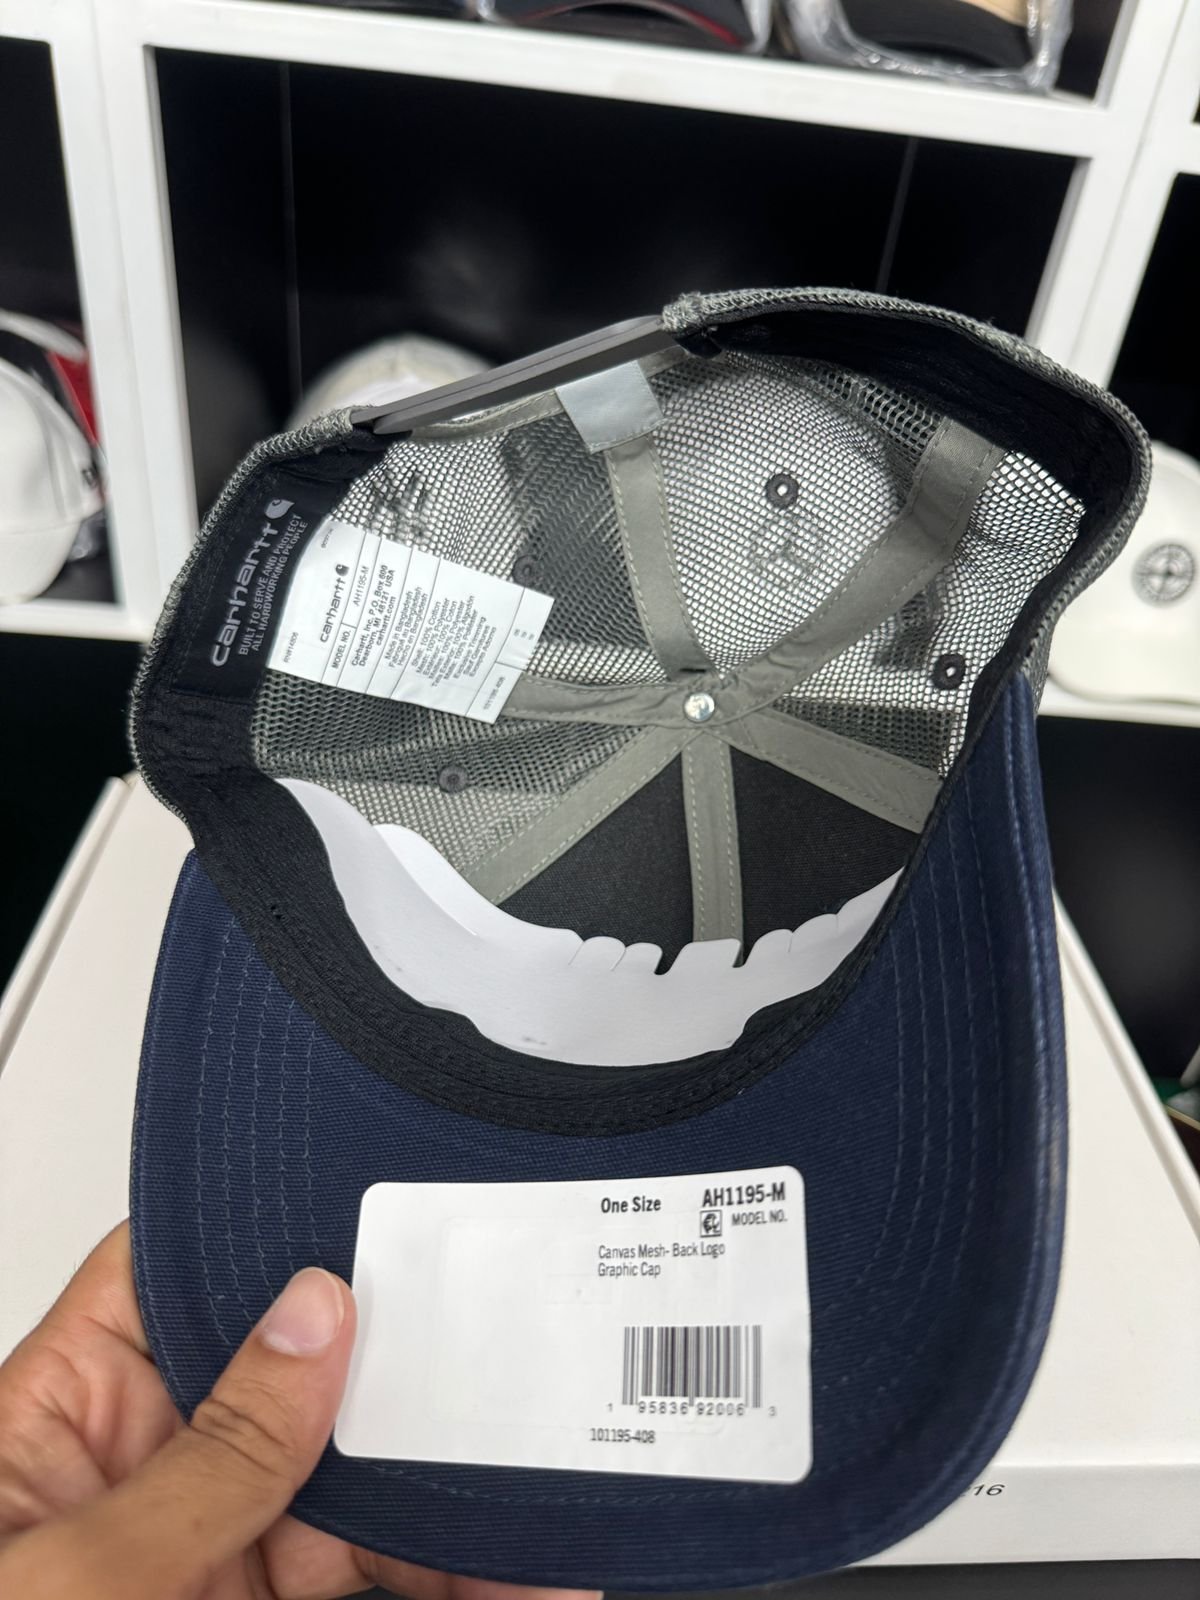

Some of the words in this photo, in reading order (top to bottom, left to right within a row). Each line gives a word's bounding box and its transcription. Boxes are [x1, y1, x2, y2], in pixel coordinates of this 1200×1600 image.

[273, 514, 302, 555] PROTECT
[262, 555, 278, 577] AND
[211, 521, 279, 668] carhartt
[251, 631, 264, 652] ALL
[258, 555, 288, 631] HARDWORKING
[282, 521, 308, 555] PEOPLE
[253, 577, 268, 610] SERVE
[353, 565, 369, 607] AH1195-M
[250, 610, 261, 625] TO
[319, 577, 345, 644] carhartt
[351, 631, 369, 667] Carhartt,
[368, 597, 380, 616] P.O.
[374, 580, 384, 597] Box
[379, 564, 388, 580] 600
[359, 628, 379, 667] Dearborn,
[377, 590, 390, 615] 48121
[385, 568, 395, 588] USA
[375, 596, 397, 646] carhartt.com
[404, 585, 424, 628] Bangladesh
[420, 626, 432, 646] 100%
[428, 600, 442, 626] Cotton
[385, 639, 397, 660] Made
[395, 590, 415, 633] Bangladesh
[397, 643, 411, 667] Hecho
[410, 592, 429, 635] Bangladesh
[426, 632, 439, 652] 100%
[433, 598, 451, 633] Polyester
[438, 623, 450, 643] 100%
[452, 625, 465, 646] 100%
[239, 627, 256, 657] BUILT
[332, 643, 346, 669] MODEL
[341, 629, 351, 643] NO.
[441, 635, 453, 655] 100%
[454, 641, 467, 660] 100%
[601, 1197, 628, 1213] One
[632, 1195, 661, 1211] Size
[702, 1182, 786, 1207] AH1195-M
[732, 1212, 767, 1226] MODEL
[770, 1209, 787, 1223] NO.
[599, 1245, 635, 1259] Canvas
[638, 1244, 669, 1258] Mesh-
[672, 1243, 698, 1257] Back
[701, 1242, 725, 1259] Logo
[598, 1262, 638, 1277] Graphic
[641, 1262, 661, 1278] Cap
[590, 1428, 655, 1444] 101195-408
[963, 1484, 1005, 1496] 16
